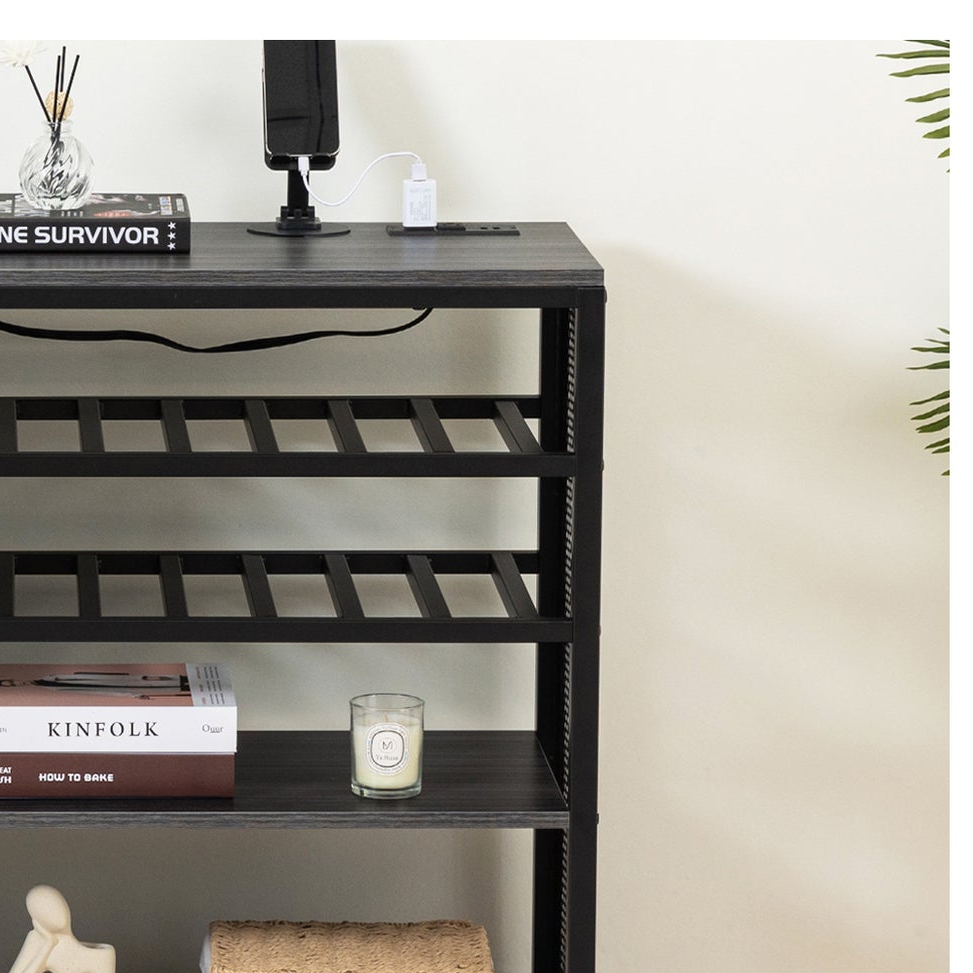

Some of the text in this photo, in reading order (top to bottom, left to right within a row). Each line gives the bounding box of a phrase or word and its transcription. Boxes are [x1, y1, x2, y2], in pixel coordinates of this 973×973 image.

[34, 226, 159, 245] SURVIVOR
[47, 721, 159, 738] KINFOLK
[38, 772, 114, 782] HOW TO BAKE
